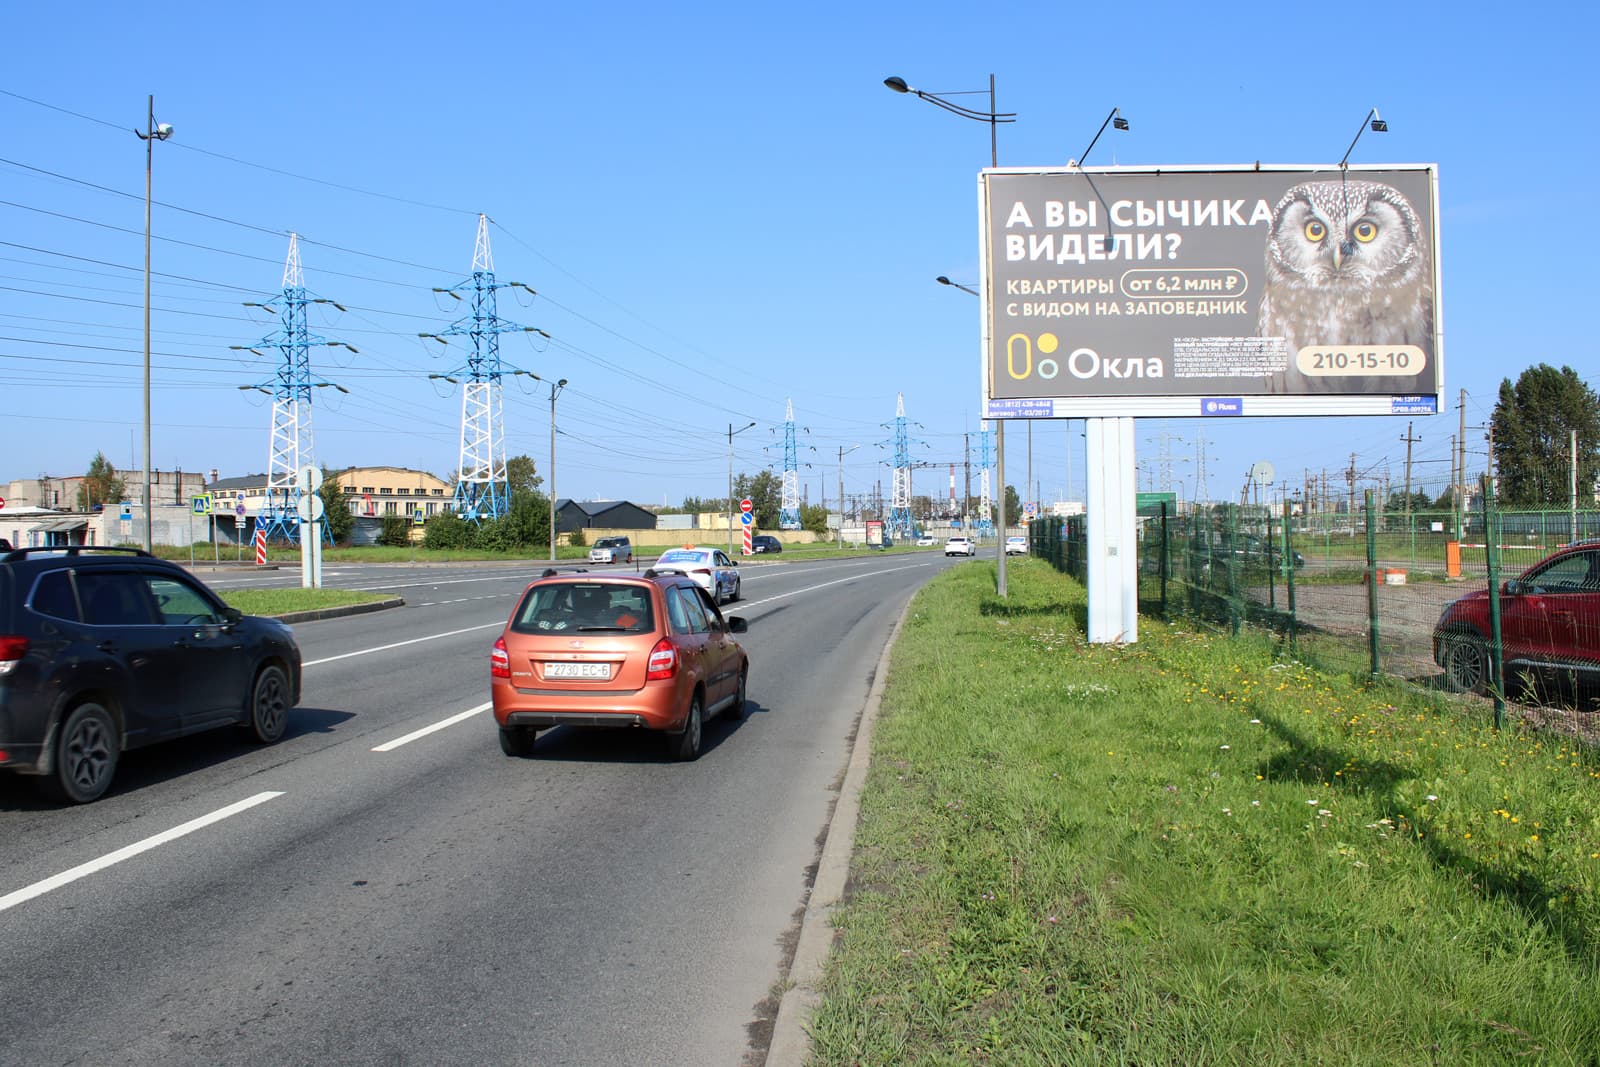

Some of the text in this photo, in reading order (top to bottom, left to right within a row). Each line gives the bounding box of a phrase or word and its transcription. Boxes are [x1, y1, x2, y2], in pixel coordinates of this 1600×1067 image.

[1006, 199, 1272, 227] А ВЫ СЫЧИКА
[1006, 233, 1182, 264] ВИДЕЛИ?
[1006, 279, 1114, 294] КВАРТИРЫ
[1130, 278, 1152, 291] от
[1156, 276, 1181, 293] 6,2
[1185, 278, 1222, 291] млн
[1006, 300, 1247, 318] С ВИДОМ НА ЗАПОВЕДНИК
[1068, 348, 1164, 379] Окла
[1313, 353, 1409, 368] 210-15-10
[554, 665, 578, 676] 2730
